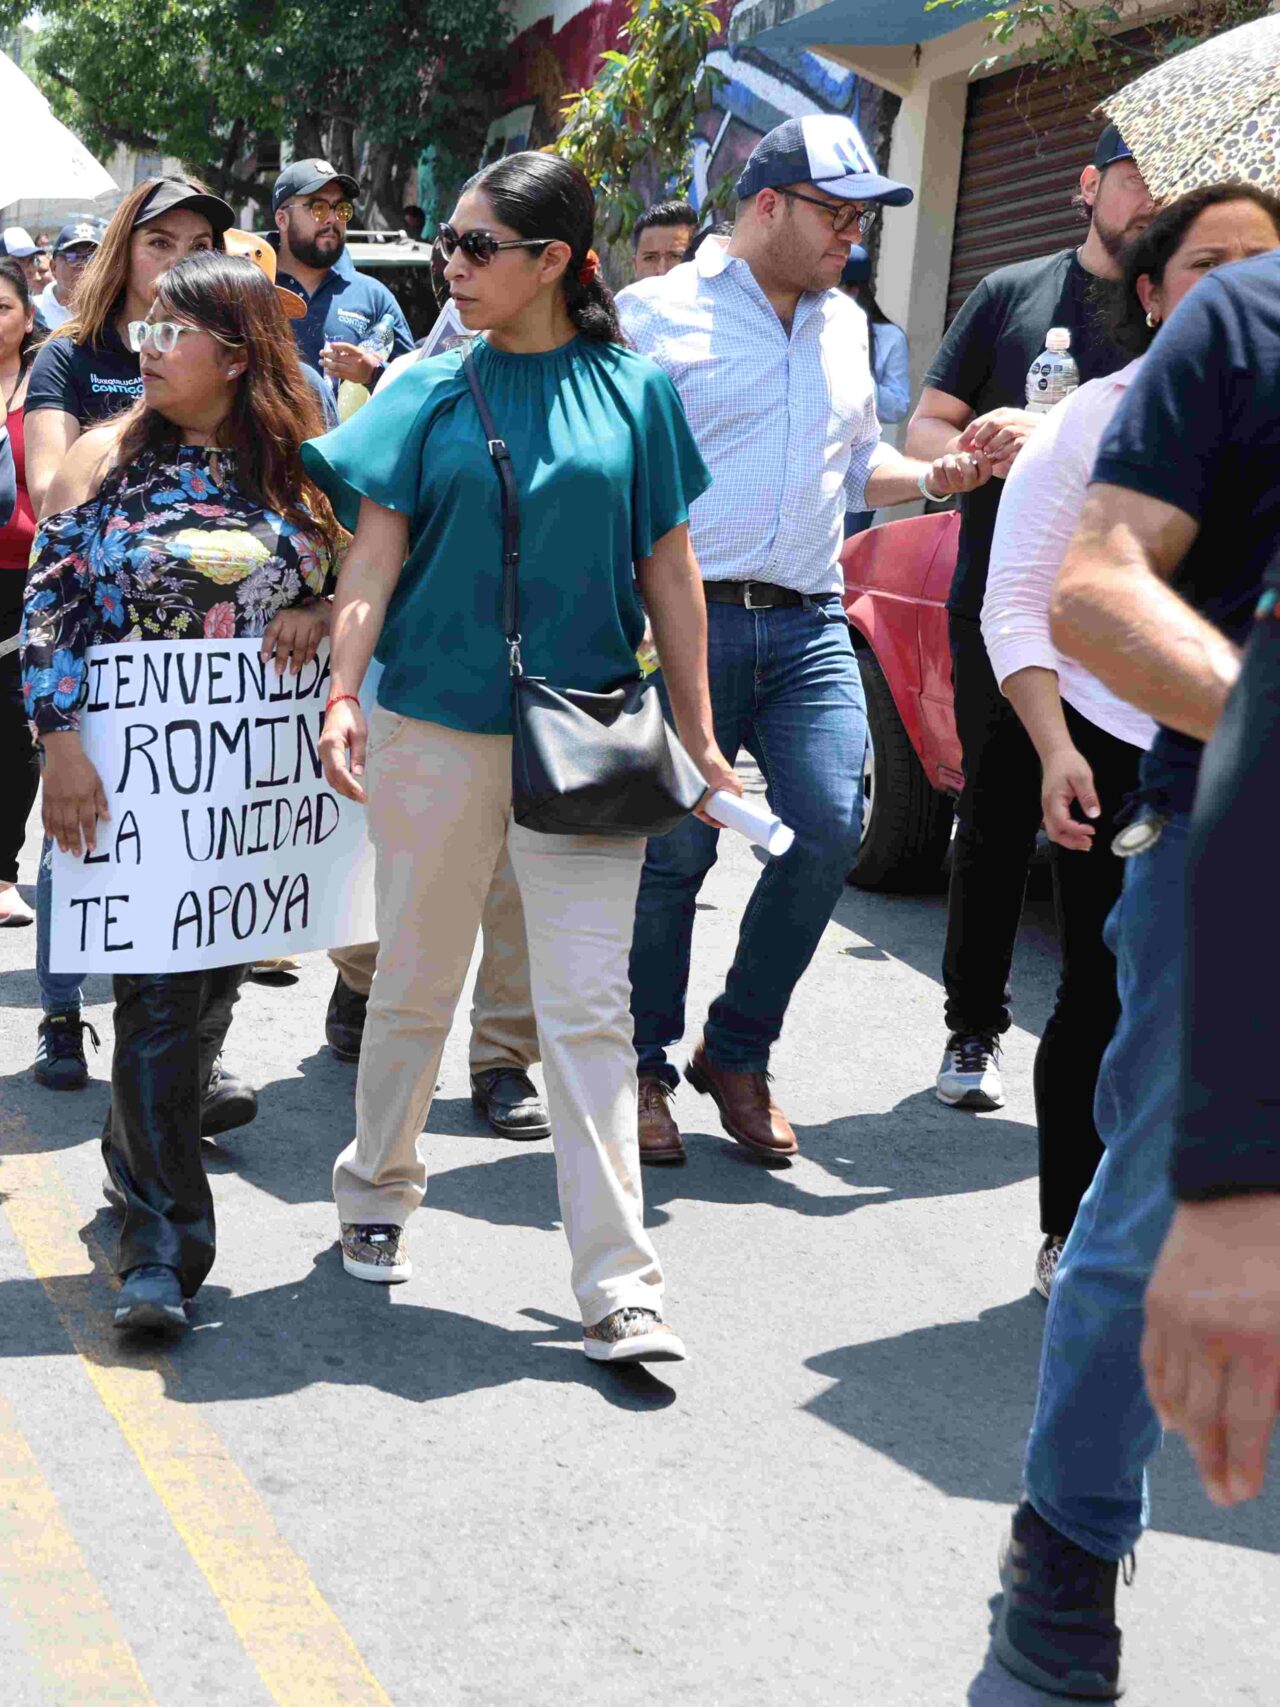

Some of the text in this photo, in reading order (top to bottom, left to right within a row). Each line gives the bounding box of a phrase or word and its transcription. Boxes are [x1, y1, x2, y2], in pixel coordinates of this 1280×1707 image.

[91, 384, 144, 395] CONTIGO
[114, 711, 326, 794] ROMIN
[181, 792, 340, 862] UNIDAD
[70, 873, 309, 952] TE APOYA
